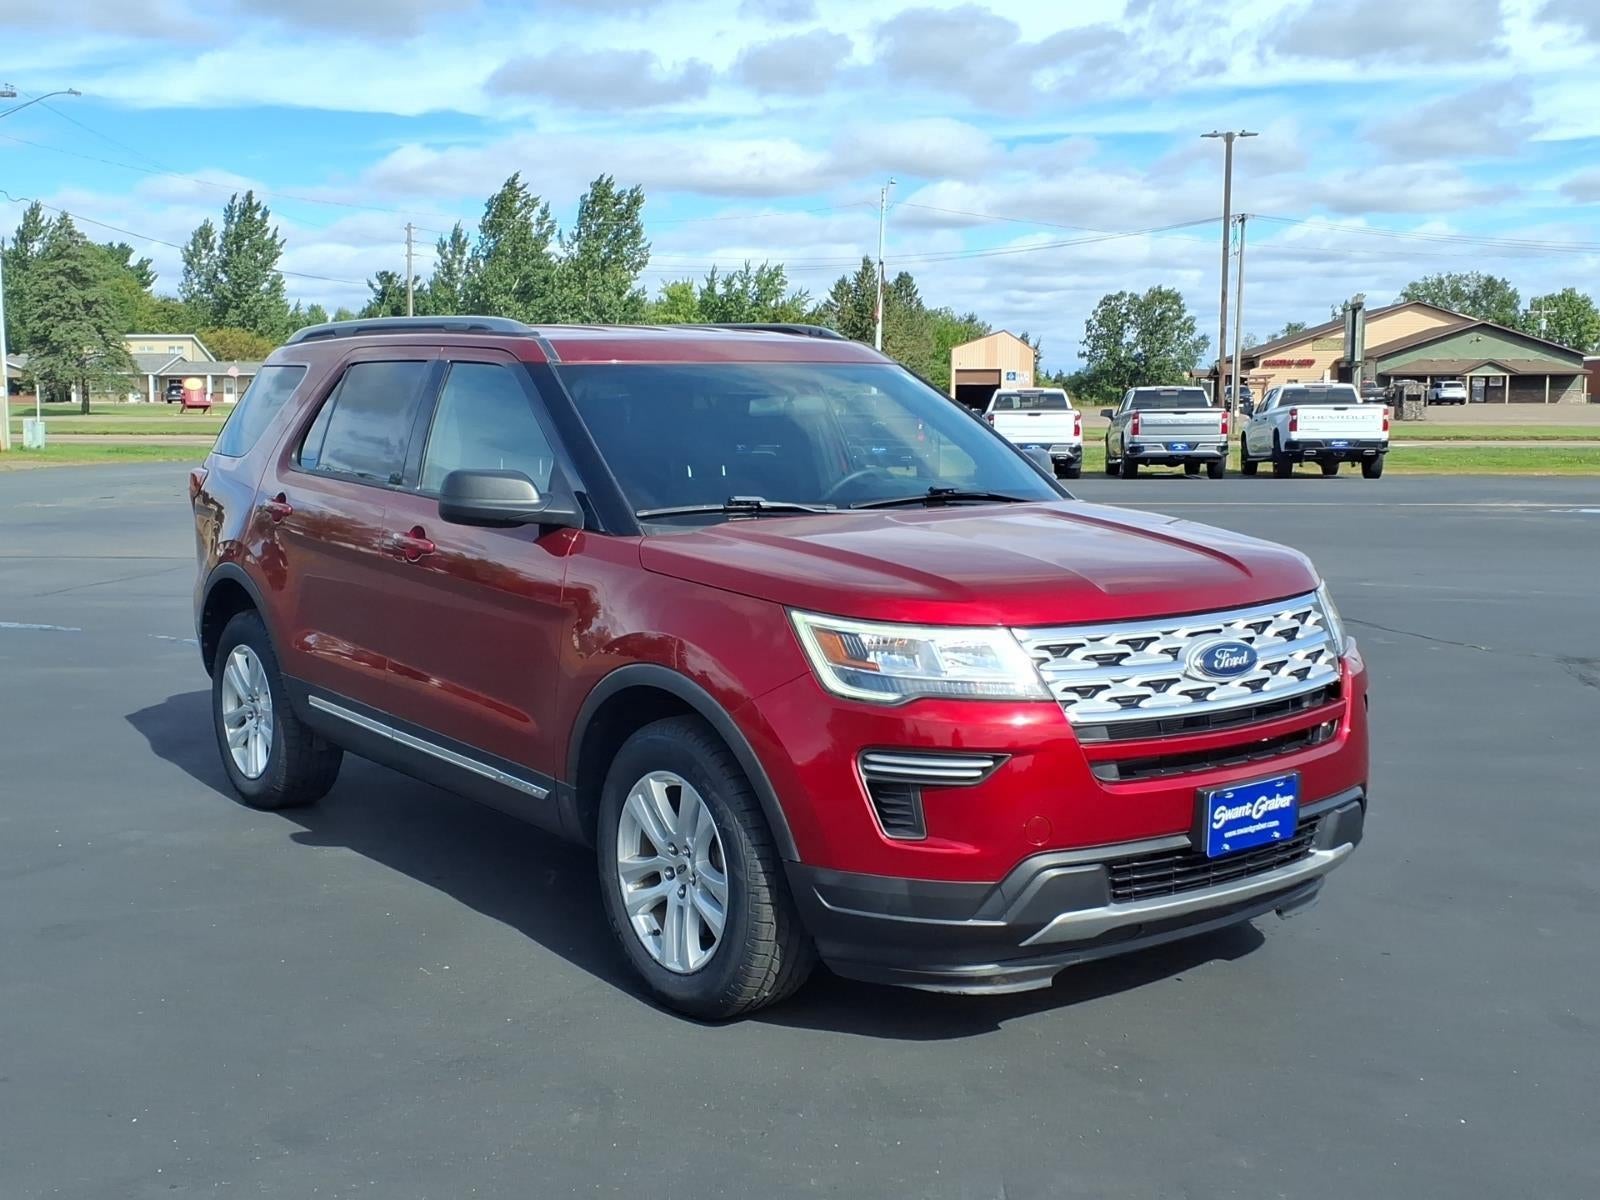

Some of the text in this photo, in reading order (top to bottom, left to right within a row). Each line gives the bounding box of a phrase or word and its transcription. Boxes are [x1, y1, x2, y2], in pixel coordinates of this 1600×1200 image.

[1213, 647, 1249, 670] Ford
[1212, 793, 1295, 829] Swant Graber
